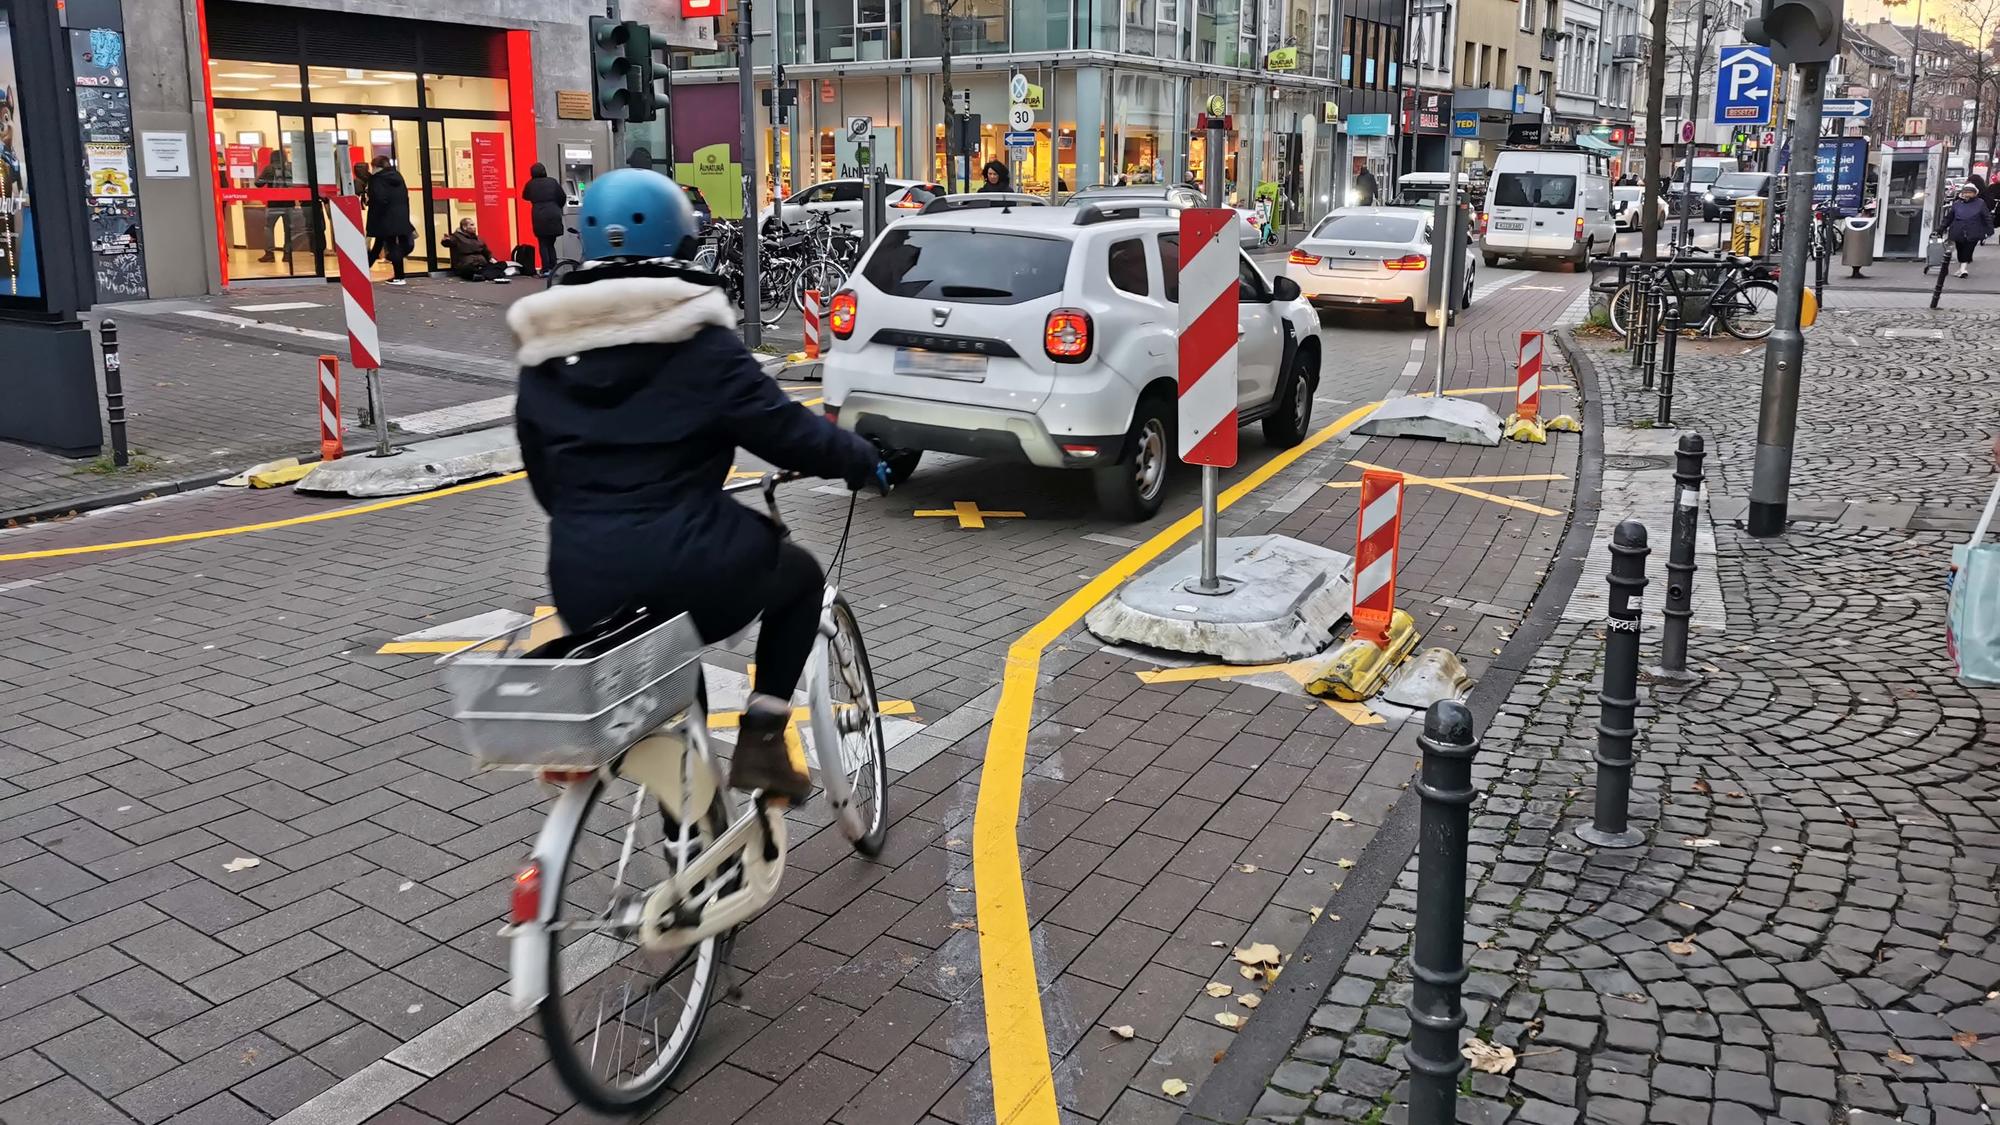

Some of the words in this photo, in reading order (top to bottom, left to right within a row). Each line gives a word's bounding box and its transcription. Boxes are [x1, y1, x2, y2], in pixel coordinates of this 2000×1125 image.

[1729, 63, 1759, 100] P
[1014, 110, 1029, 124] 30
[854, 122, 865, 132] 20
[1909, 120, 1923, 134] T
[1817, 165, 1849, 173] daurt
[905, 336, 985, 350] USTER
